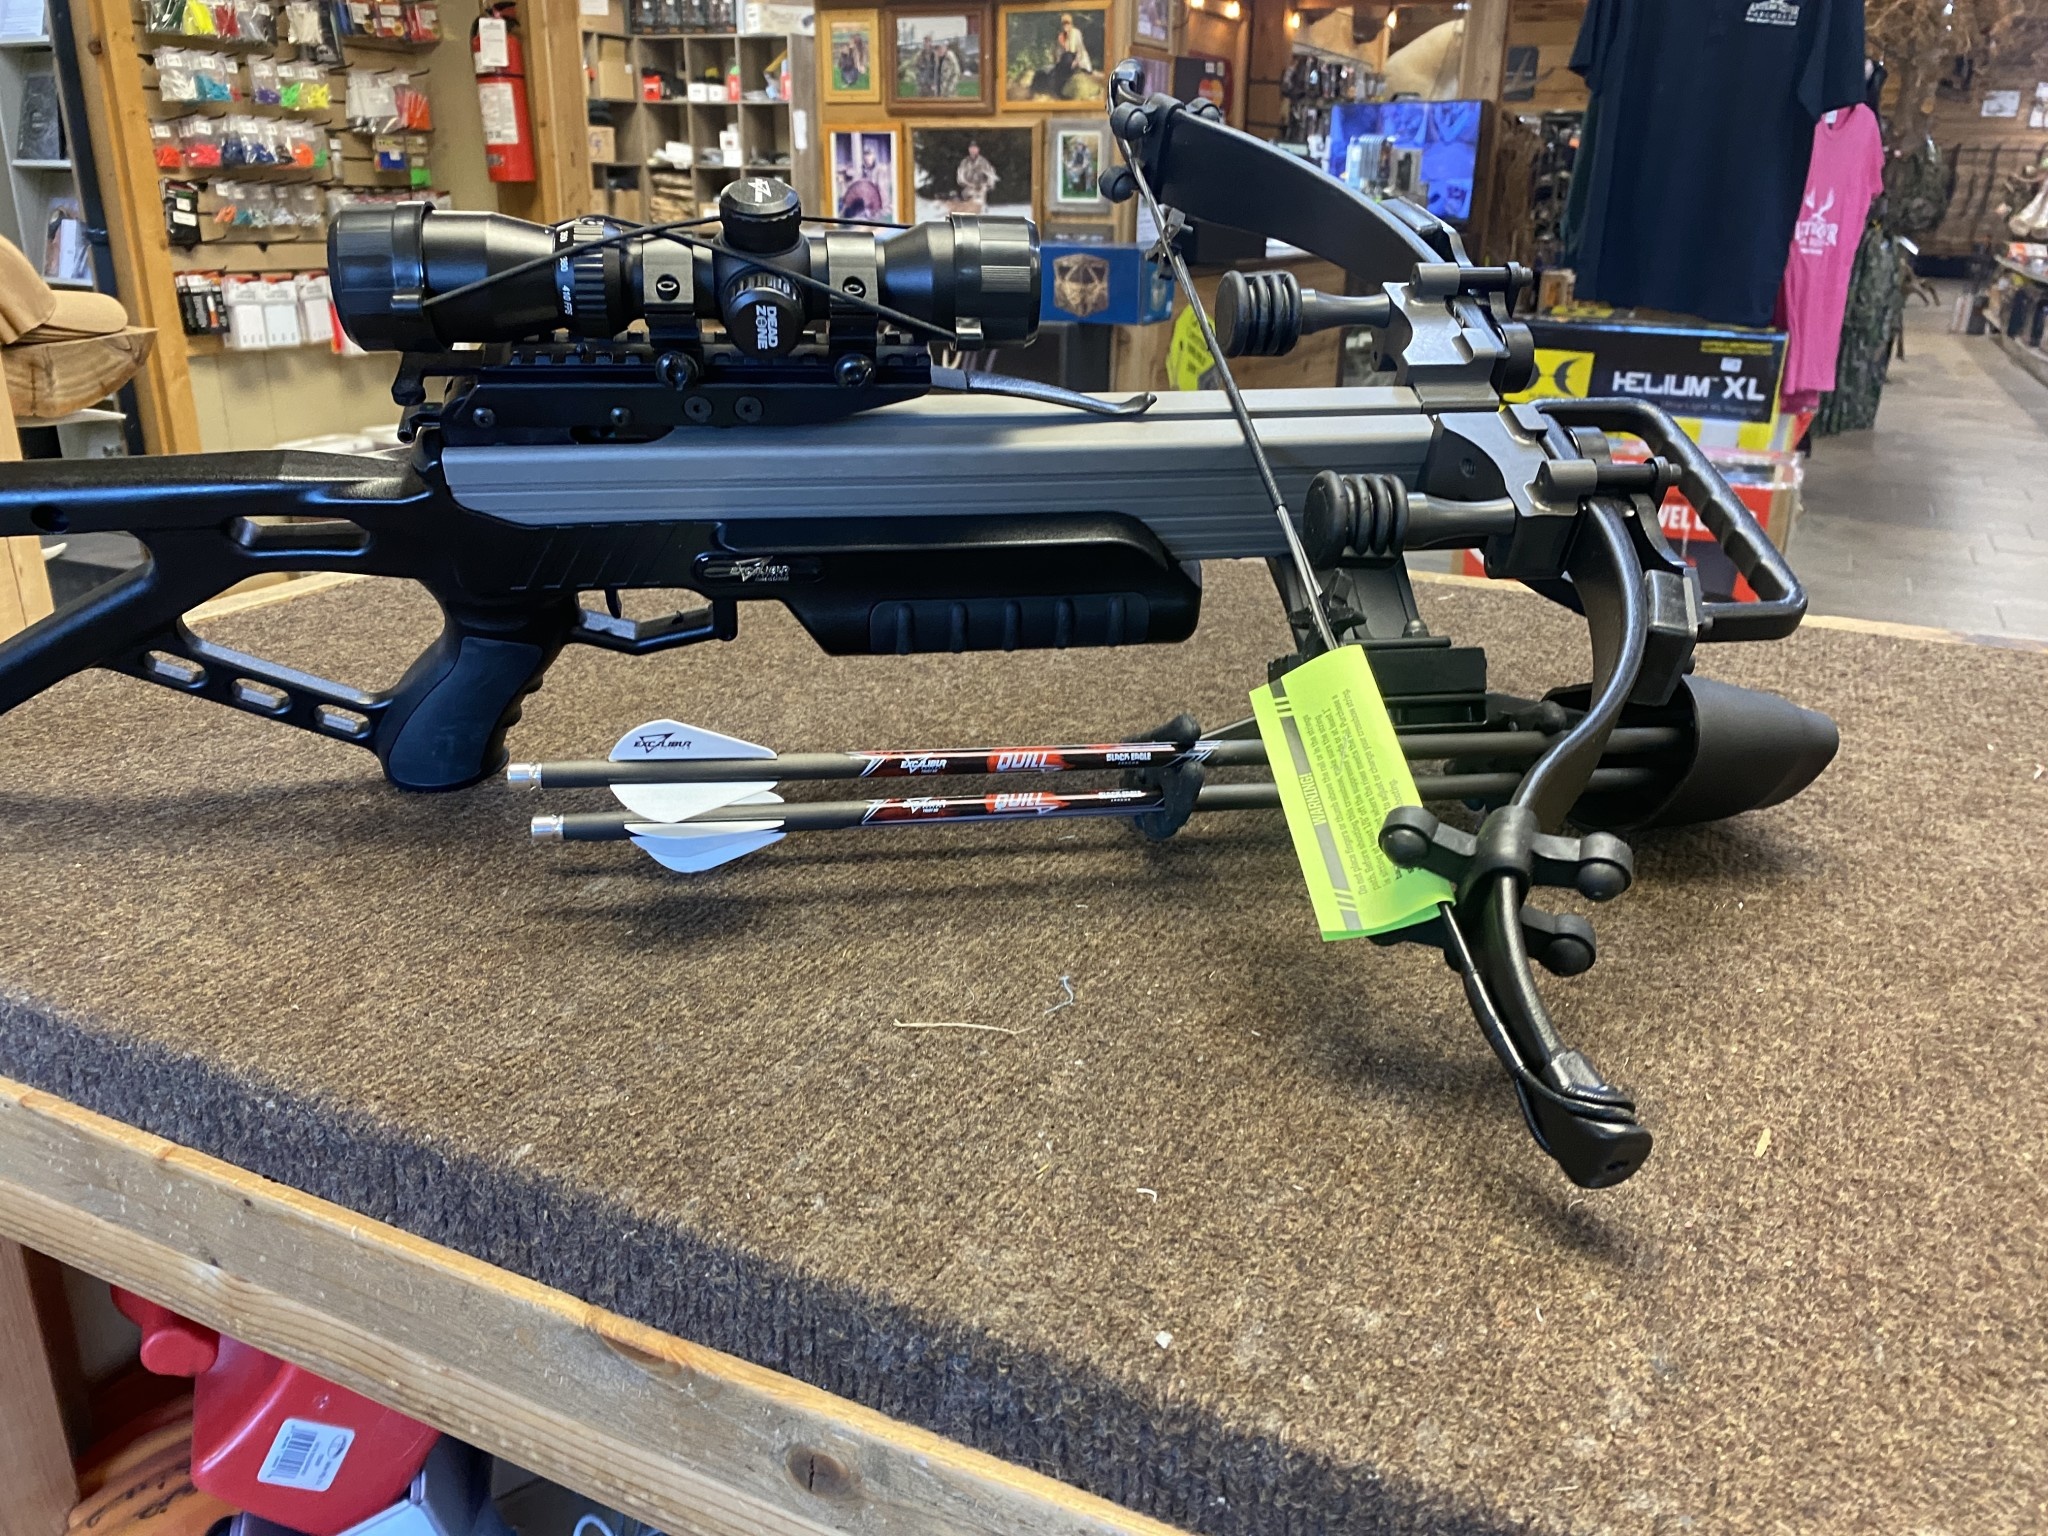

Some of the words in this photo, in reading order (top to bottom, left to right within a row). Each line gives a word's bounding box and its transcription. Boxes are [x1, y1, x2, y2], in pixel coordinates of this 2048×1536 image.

[562, 285, 571, 301] 410
[756, 304, 768, 350] ZONE
[767, 306, 779, 348] DEAD
[1612, 371, 1711, 398] HELIUM
[1721, 376, 1766, 401] XL
[1106, 753, 1130, 762] BLACK
[1298, 772, 1326, 825] WARNING!
[1386, 778, 1404, 805] hooting.
